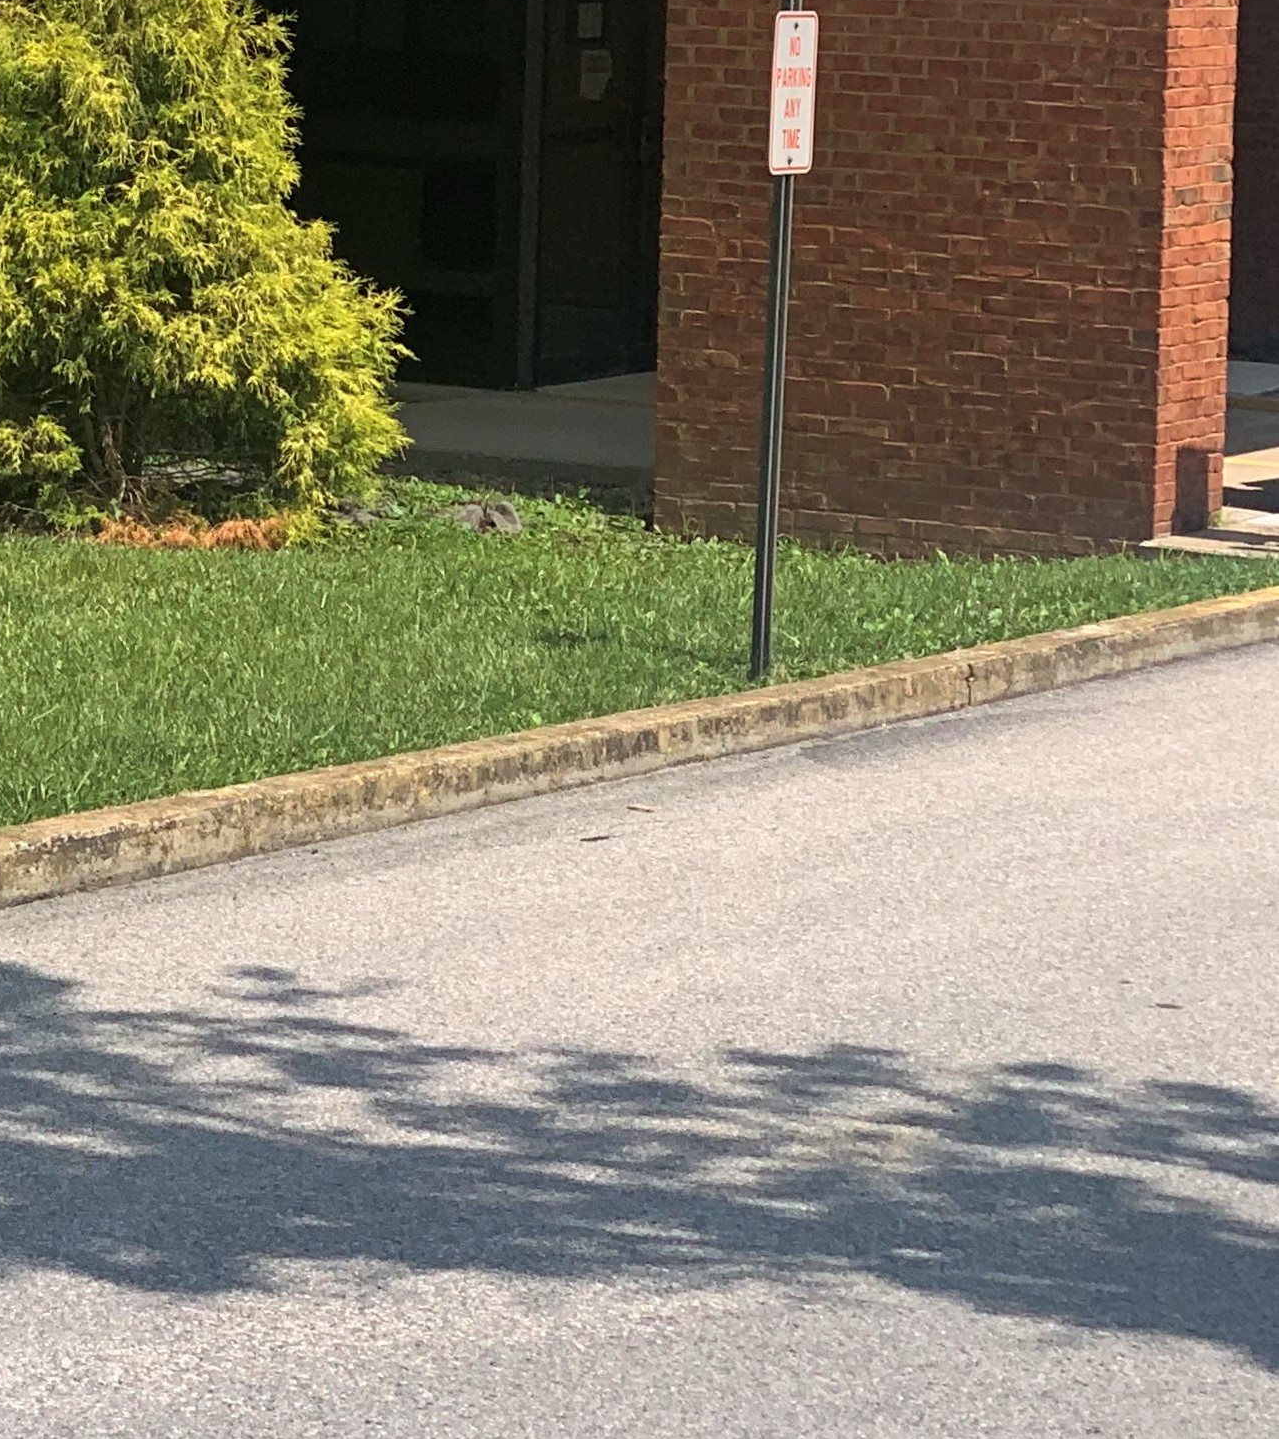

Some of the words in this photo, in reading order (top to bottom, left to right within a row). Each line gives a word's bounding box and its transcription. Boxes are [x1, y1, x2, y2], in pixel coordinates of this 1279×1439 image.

[788, 36, 802, 56] NO
[776, 67, 812, 88] PARKING
[783, 98, 802, 119] ANY
[782, 129, 801, 149] TIME
